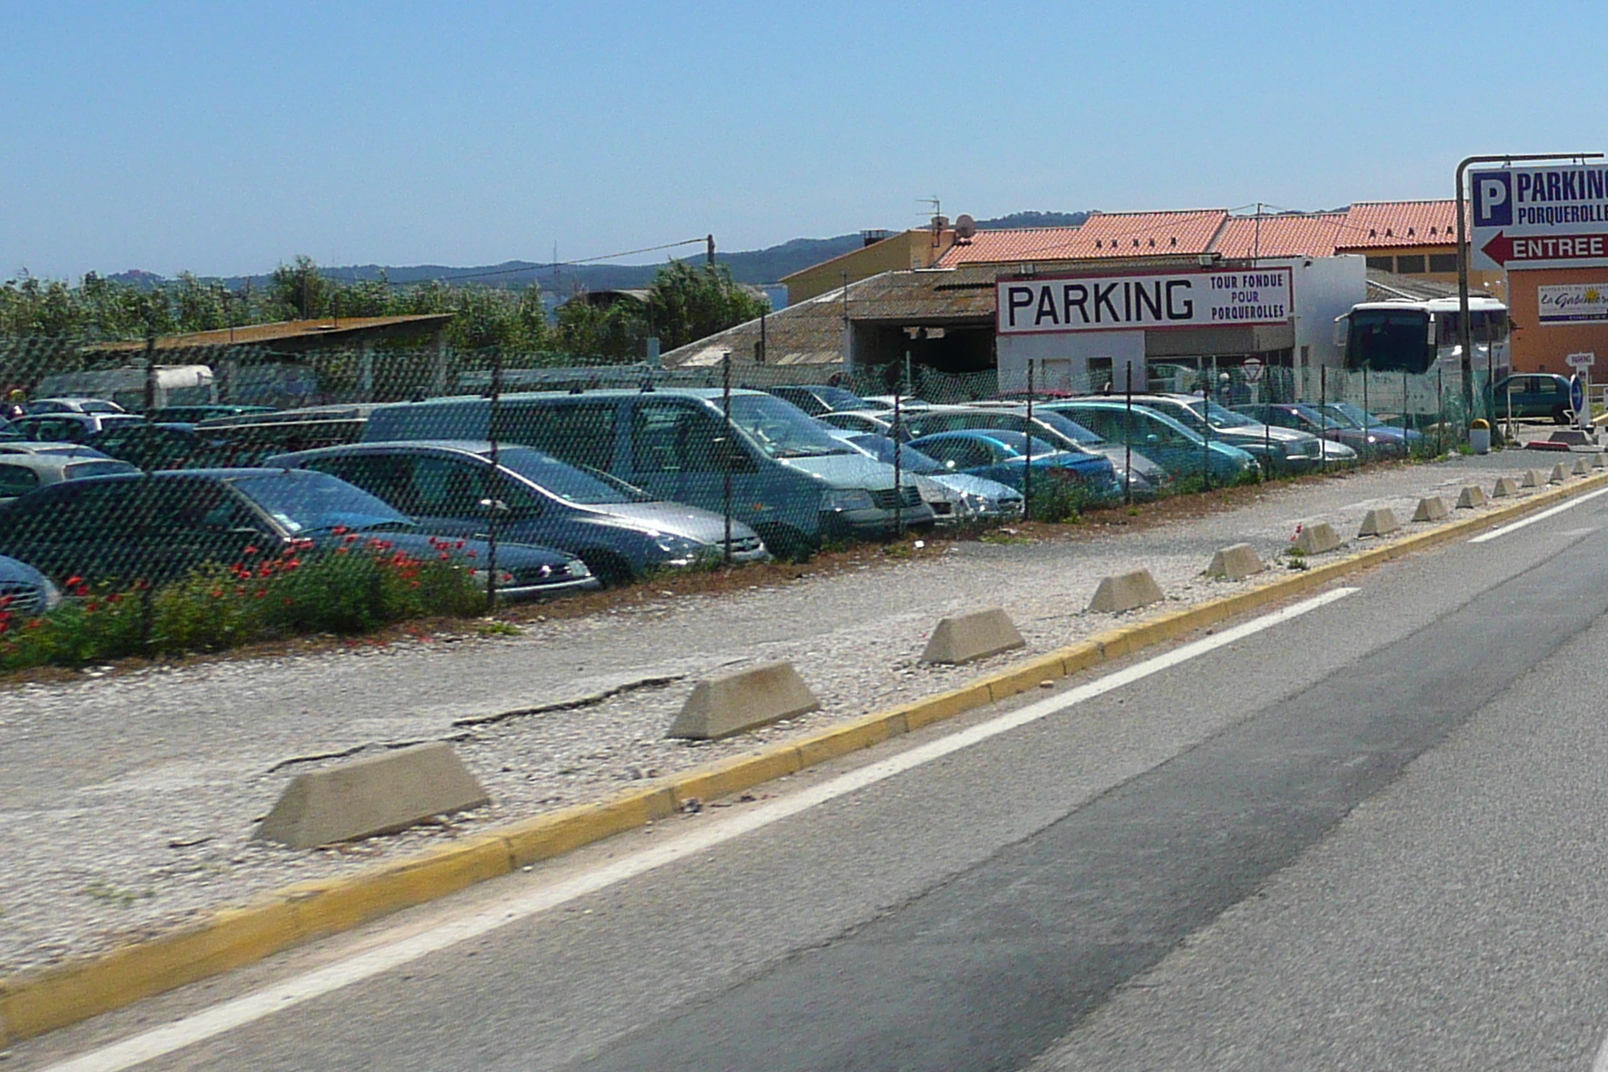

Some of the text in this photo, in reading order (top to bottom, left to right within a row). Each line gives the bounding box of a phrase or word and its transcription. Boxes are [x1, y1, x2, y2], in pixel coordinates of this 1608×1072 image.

[1480, 179, 1507, 220] P
[1512, 237, 1604, 258] ENTREE
[1210, 274, 1284, 289] TOUR FONDUE
[1008, 279, 1194, 327] PARKING
[1231, 290, 1260, 304] POUR
[1211, 304, 1285, 320] PORQUEROLLES
